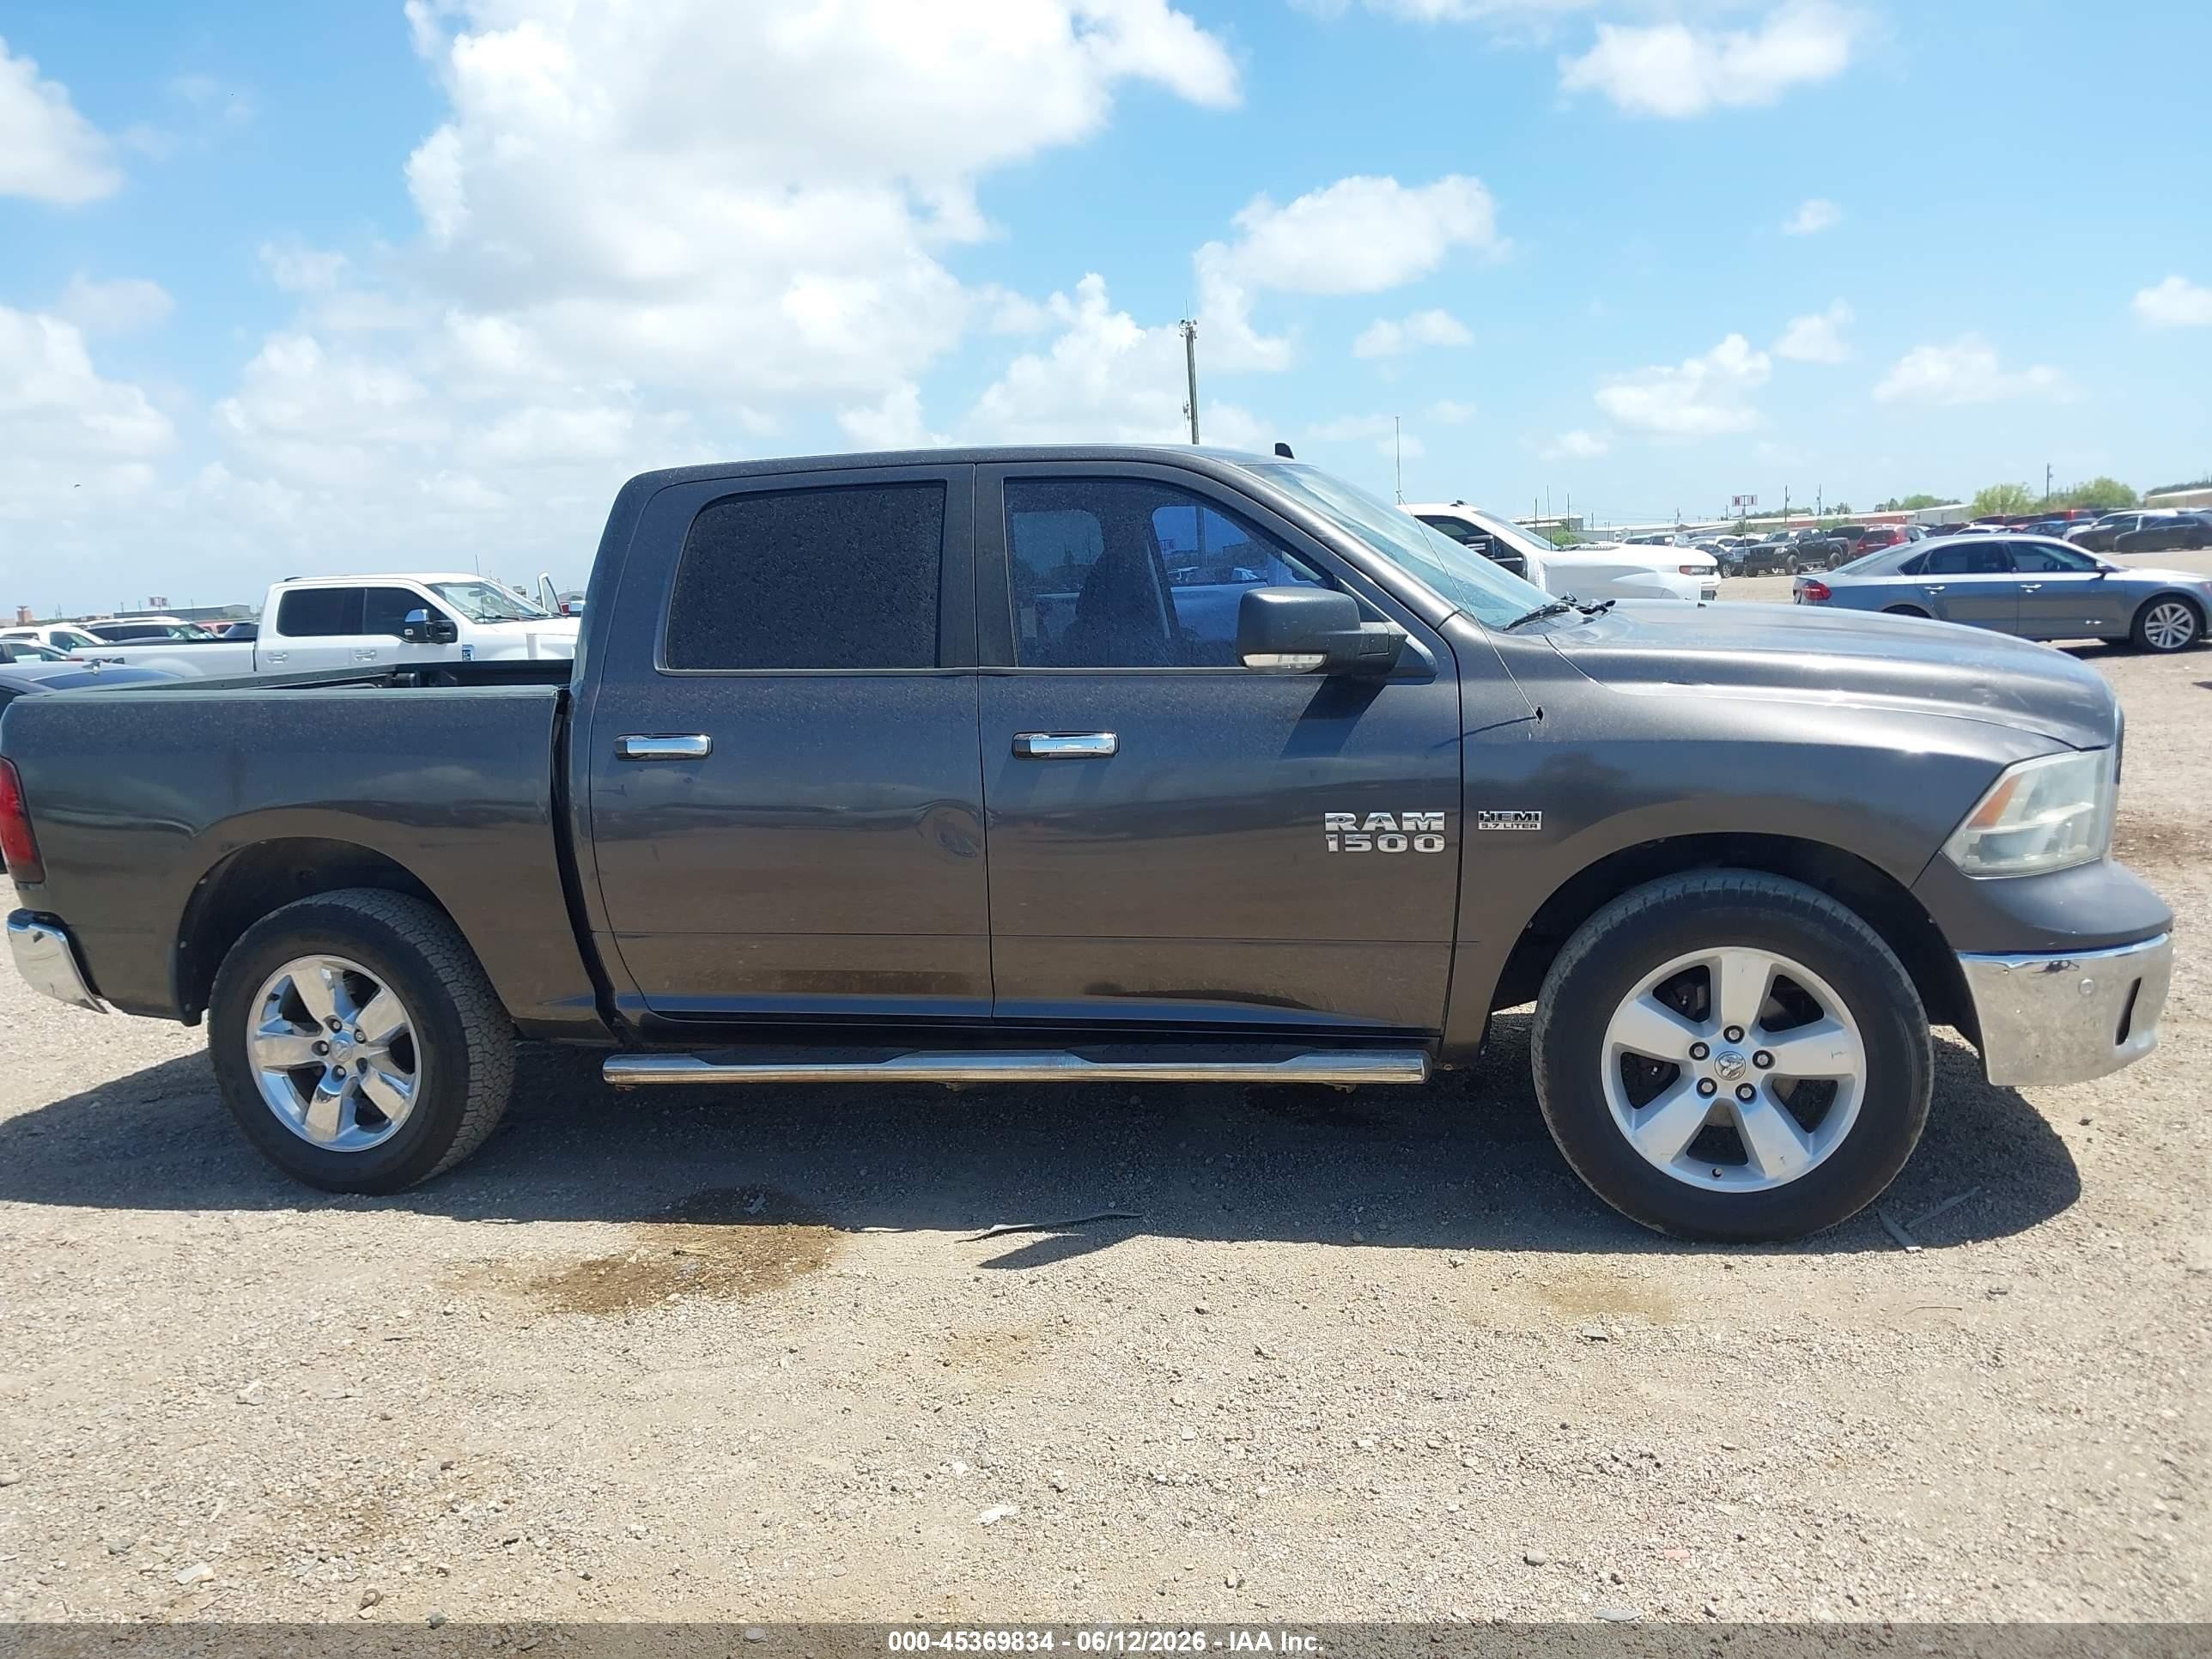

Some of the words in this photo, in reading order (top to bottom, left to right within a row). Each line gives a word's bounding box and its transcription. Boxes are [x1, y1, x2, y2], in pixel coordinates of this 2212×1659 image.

[1324, 811, 1445, 831] RAM
[1479, 811, 1540, 822] HEMI
[1325, 833, 1445, 853] 1500
